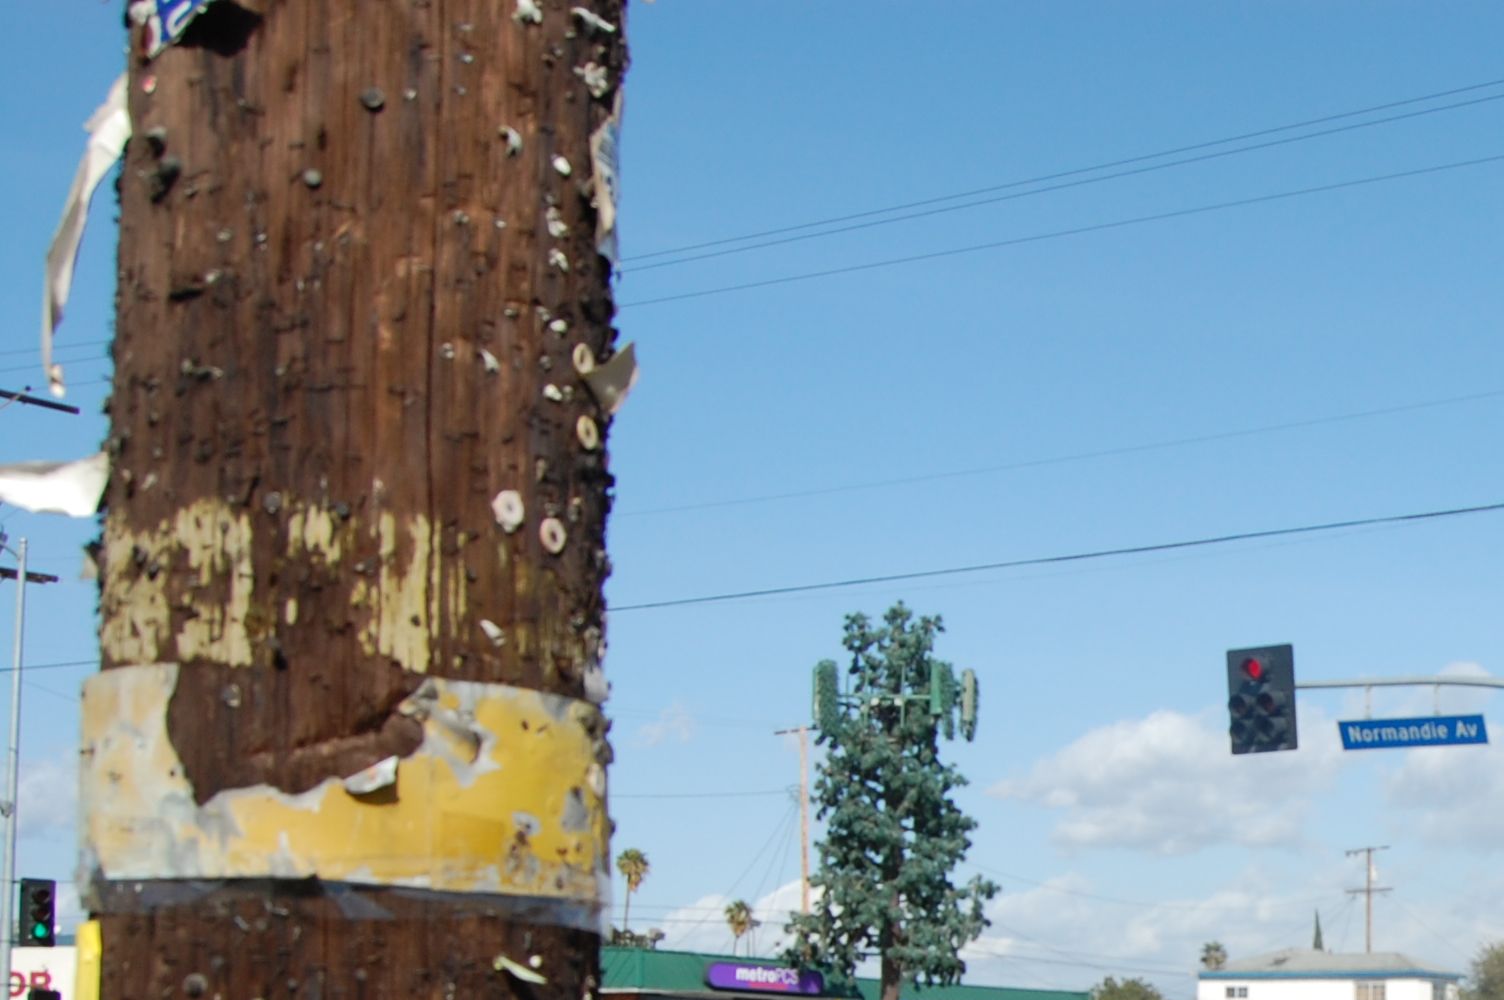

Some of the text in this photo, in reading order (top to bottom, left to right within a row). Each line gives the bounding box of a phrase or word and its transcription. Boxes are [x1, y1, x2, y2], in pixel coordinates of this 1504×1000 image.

[1347, 719, 1479, 743] Normandie Av
[735, 966, 799, 985] metroPCS
